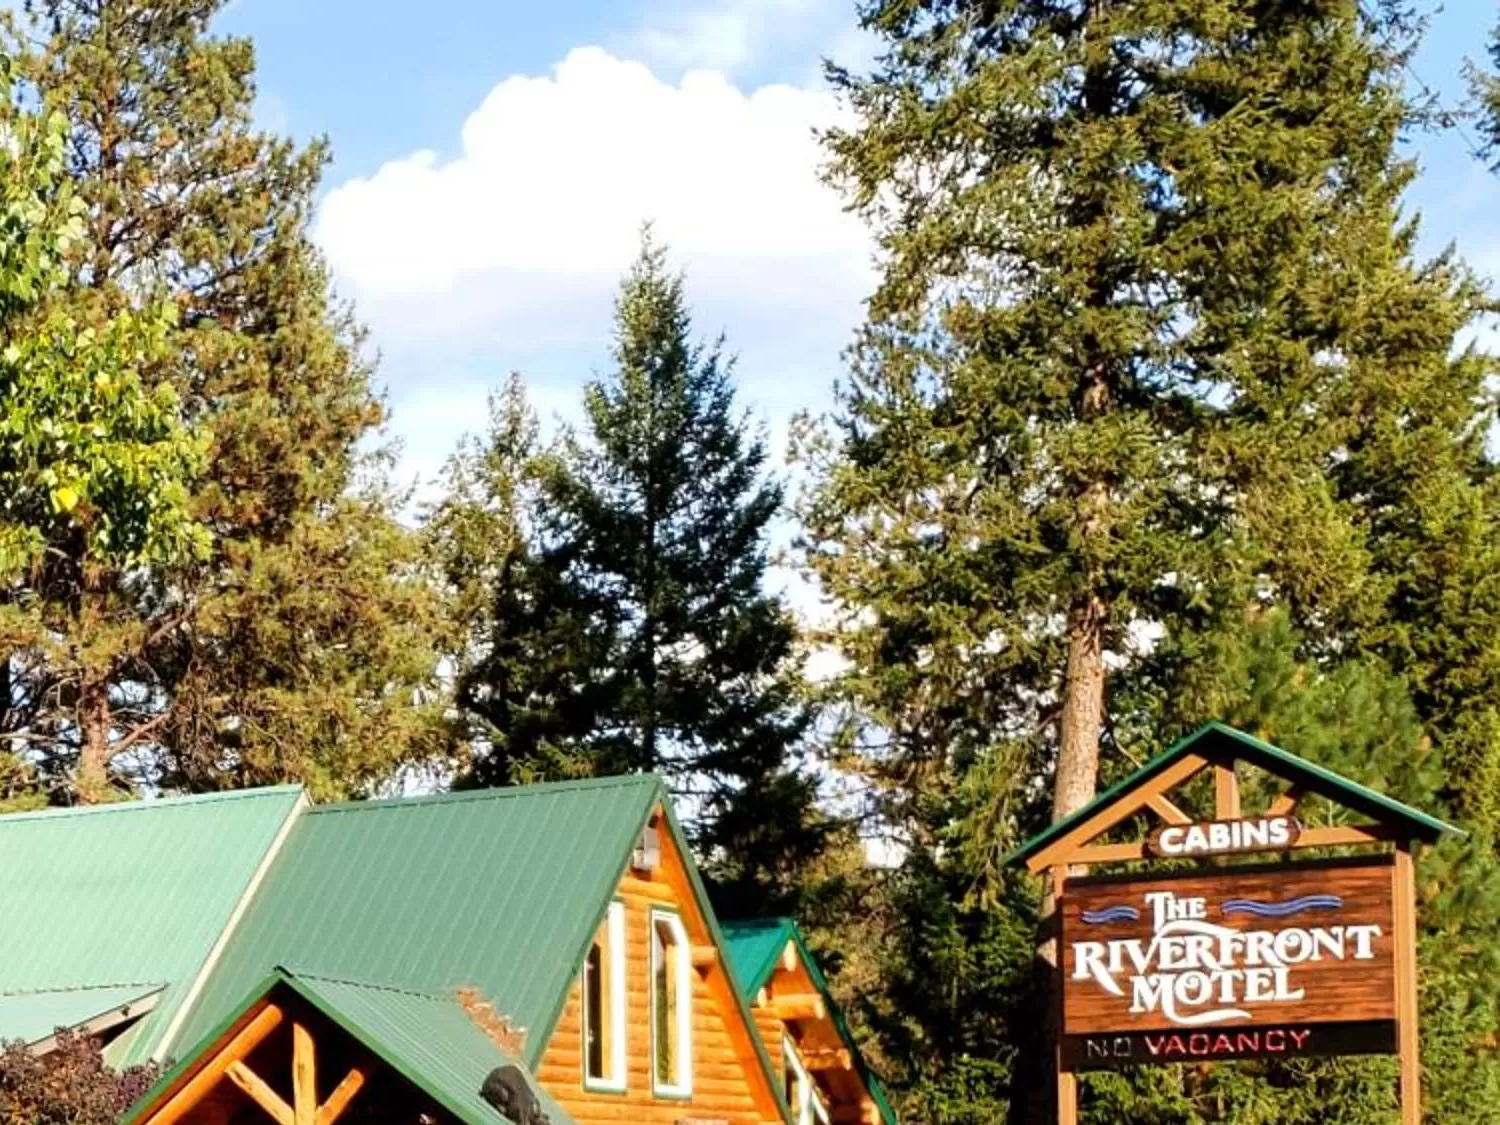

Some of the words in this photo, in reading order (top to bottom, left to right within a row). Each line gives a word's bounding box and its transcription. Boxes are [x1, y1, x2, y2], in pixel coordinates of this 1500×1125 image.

[1159, 818, 1290, 853] CABINS
[1144, 891, 1206, 931] THE
[1071, 921, 1381, 996] RIVERFRONT
[1128, 967, 1305, 1025] MOTEL
[1087, 1037, 1132, 1057] NO
[1145, 1029, 1311, 1055] VACANCY
